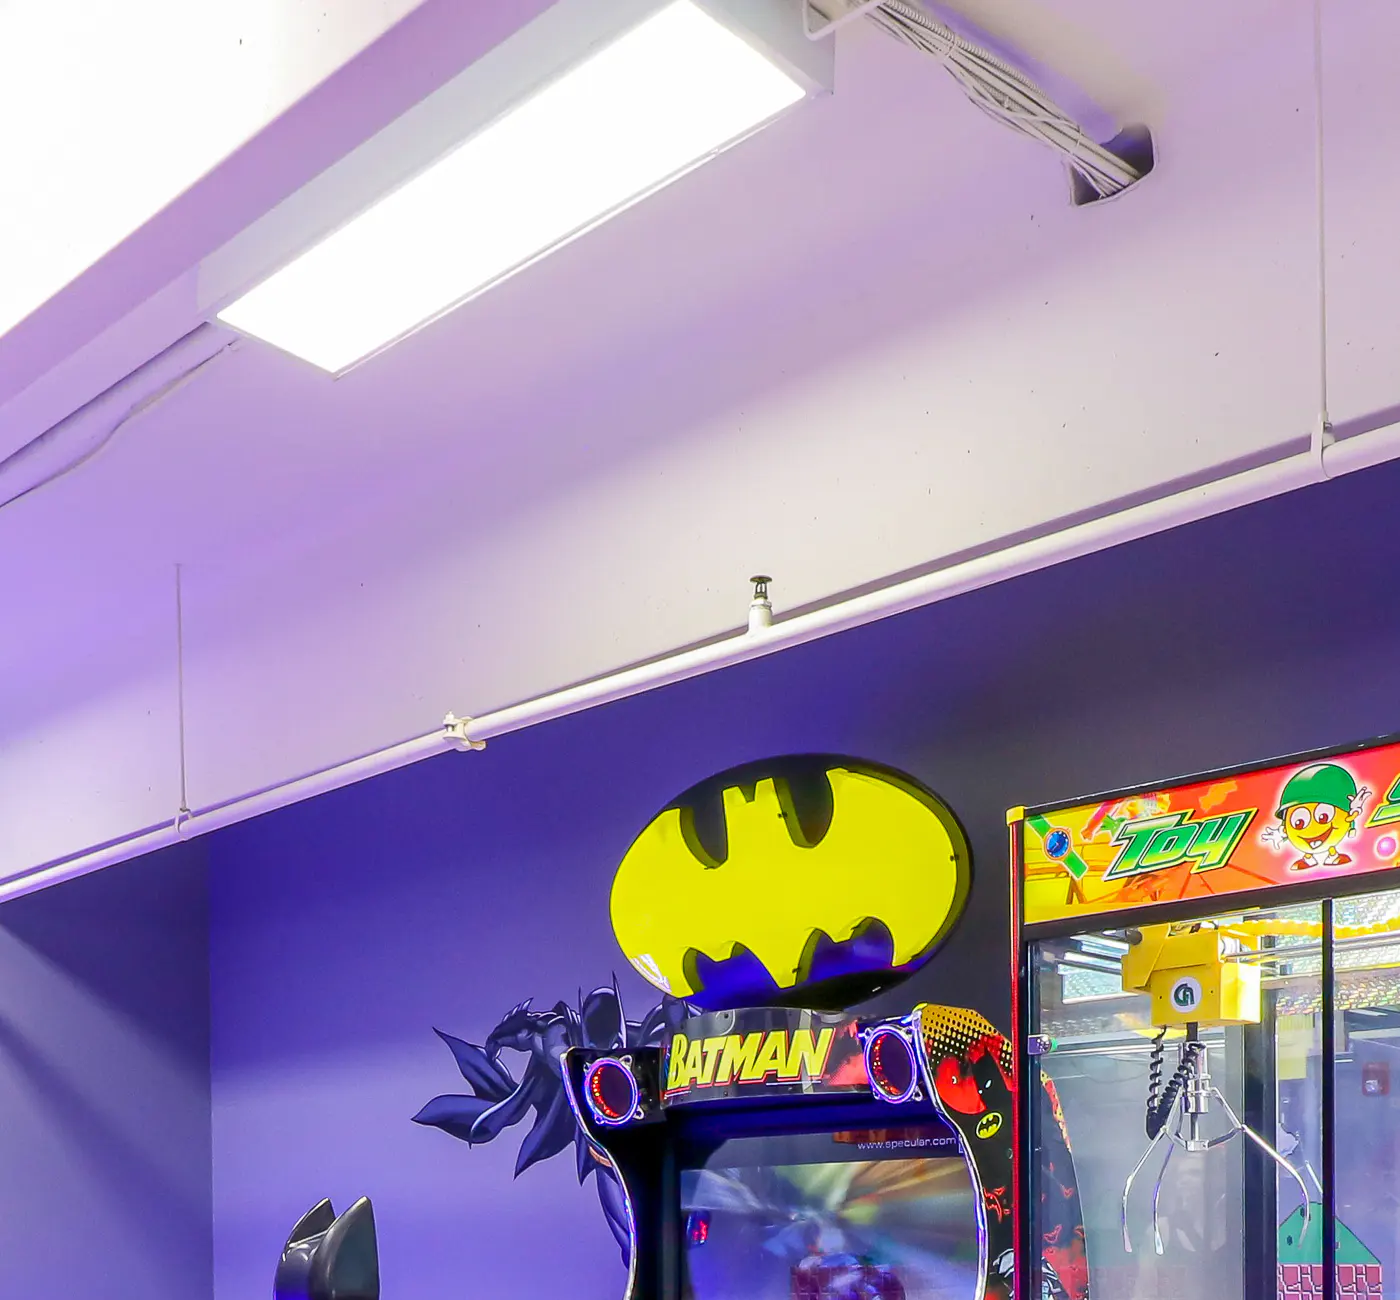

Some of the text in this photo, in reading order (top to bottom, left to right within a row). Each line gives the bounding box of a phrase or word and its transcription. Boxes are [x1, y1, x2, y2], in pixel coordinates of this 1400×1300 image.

[1105, 809, 1255, 880] Toy
[666, 1028, 835, 1092] BATMAN
[858, 1136, 957, 1150] www.specular.com
